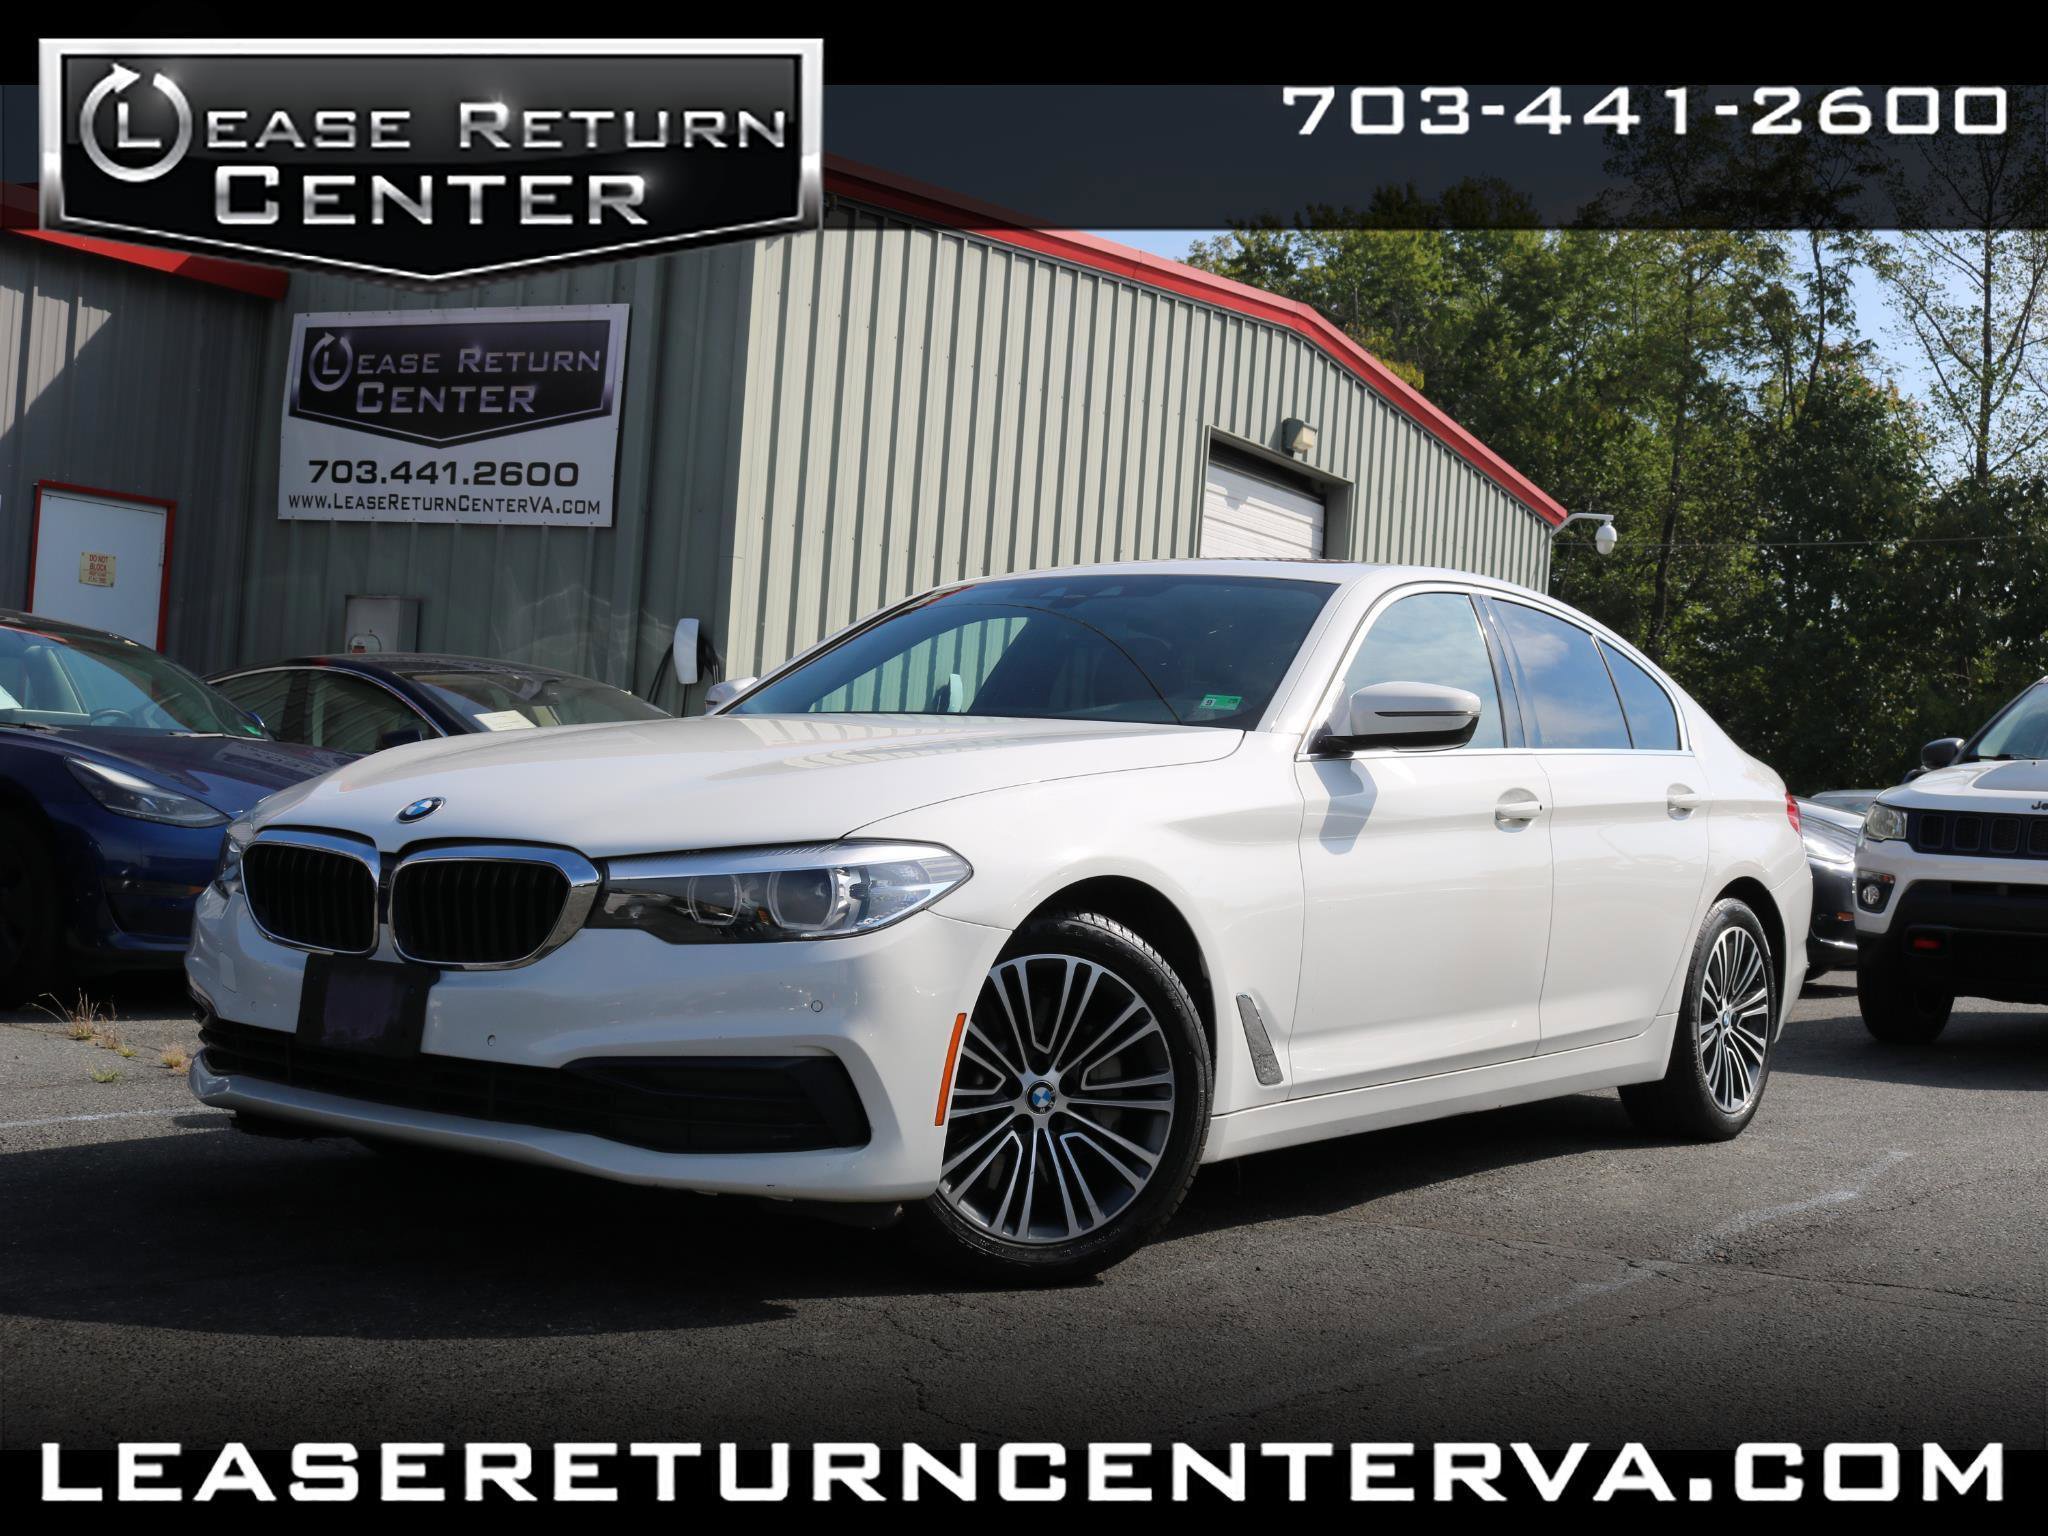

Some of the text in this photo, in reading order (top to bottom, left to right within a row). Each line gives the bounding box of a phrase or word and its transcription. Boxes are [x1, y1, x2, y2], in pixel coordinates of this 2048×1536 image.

[457, 348, 601, 373] RETURN
[355, 381, 536, 414] CENTER
[308, 459, 580, 487] 703.441.2600
